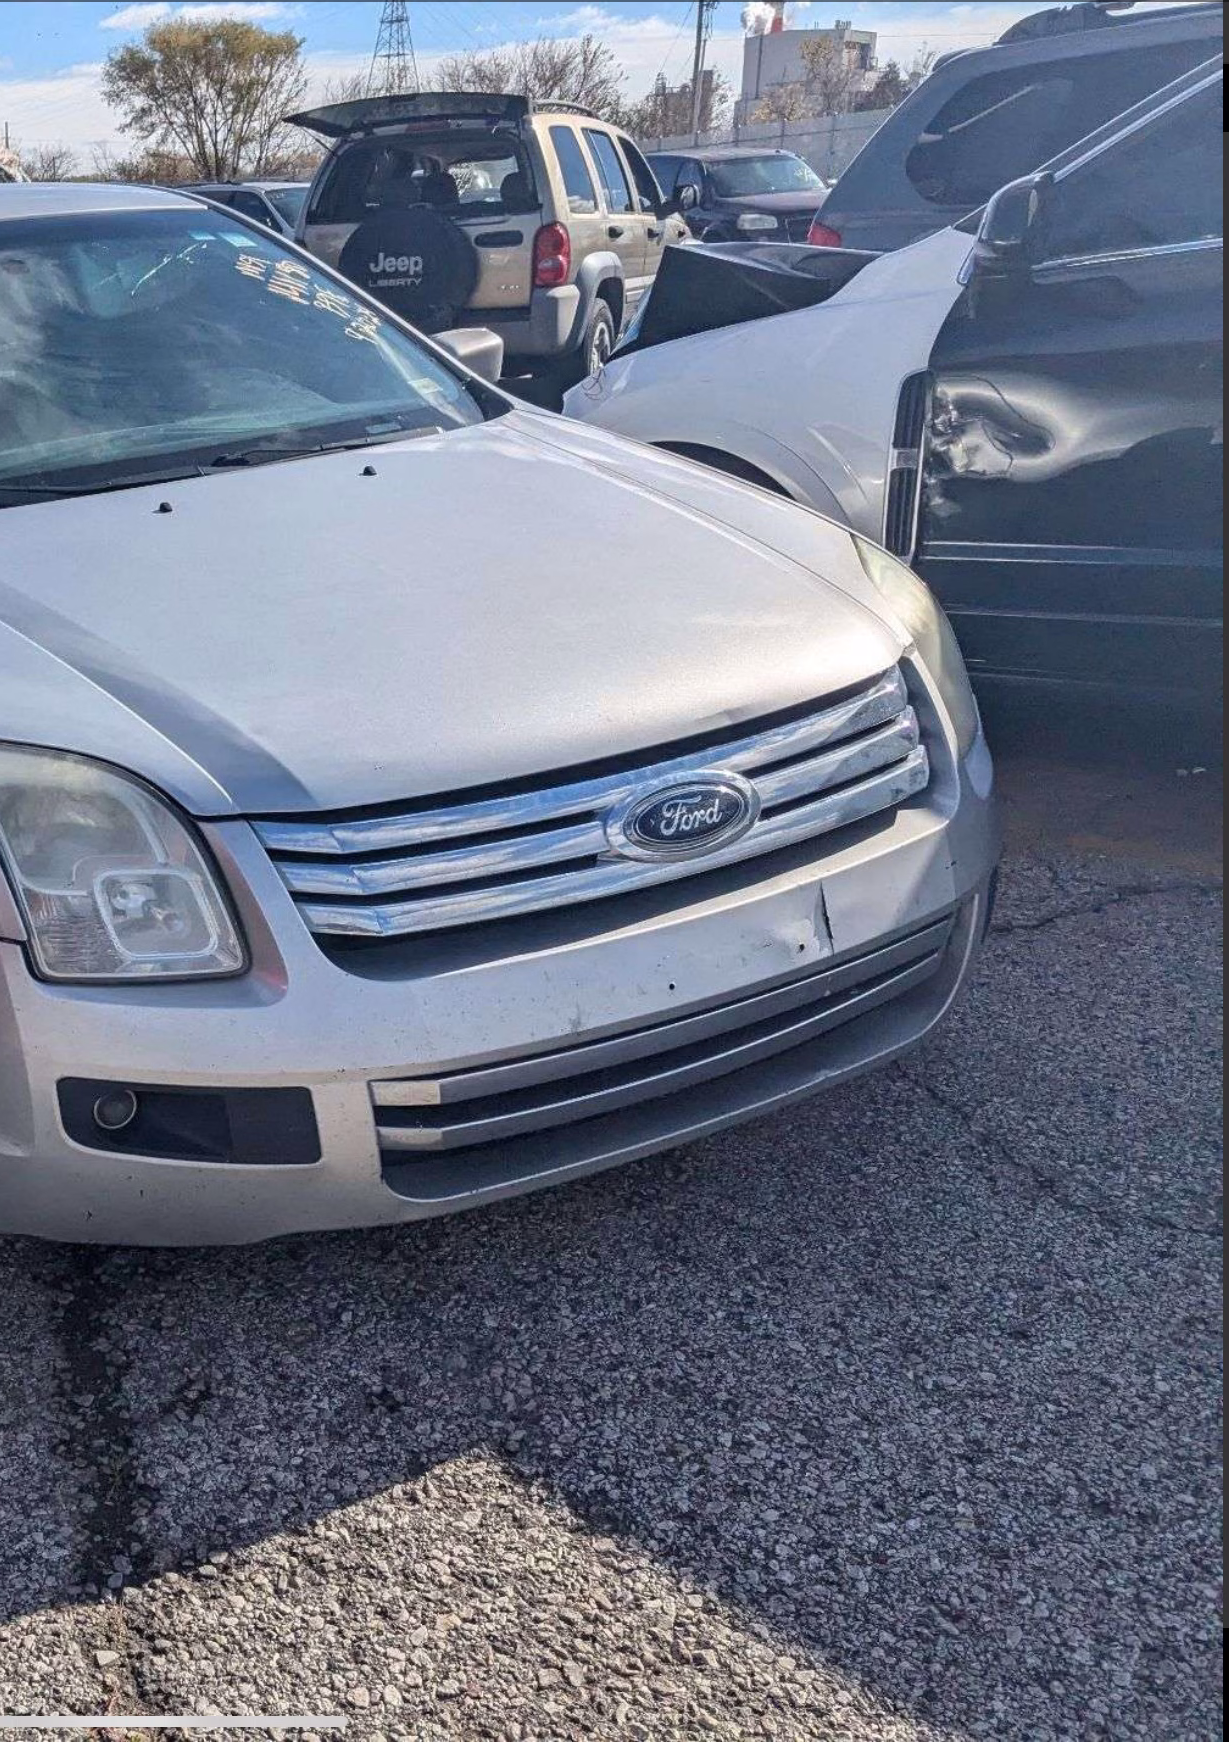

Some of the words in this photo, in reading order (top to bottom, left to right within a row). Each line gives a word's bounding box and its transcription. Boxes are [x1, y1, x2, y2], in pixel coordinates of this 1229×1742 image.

[369, 252, 423, 275] Jeep
[369, 277, 422, 288] LIBERTY
[660, 795, 723, 836] Ford
